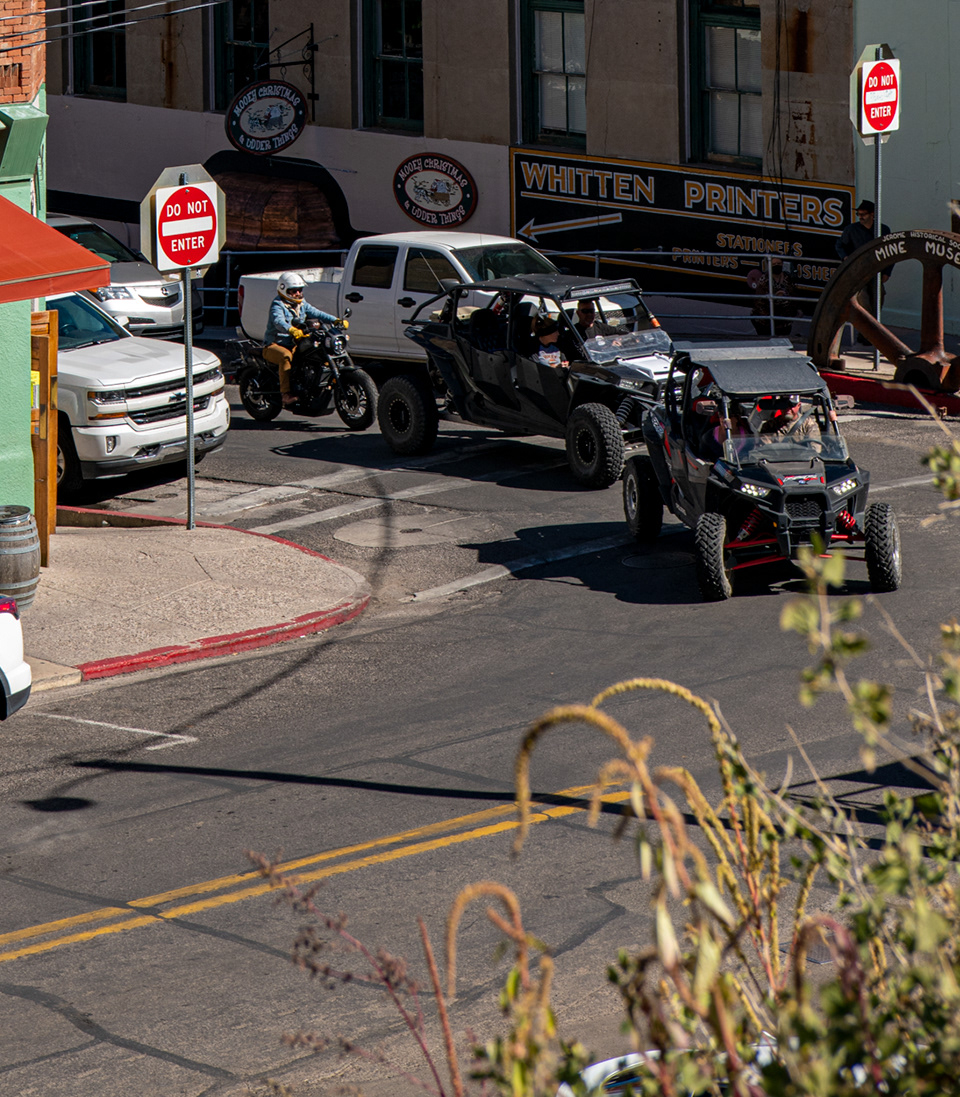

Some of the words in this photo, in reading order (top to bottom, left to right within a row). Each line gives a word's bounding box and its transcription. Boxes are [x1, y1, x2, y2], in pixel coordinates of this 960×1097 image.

[868, 76, 878, 88] DO
[881, 74, 894, 86] NOT
[233, 89, 257, 117] MOOEY
[258, 85, 301, 106] CHRISTMAS
[870, 105, 892, 119] ENTER
[246, 138, 272, 151] UDDER
[272, 123, 299, 149] THINGS
[398, 158, 423, 181] MOOEY
[424, 158, 468, 188] CHRISTMAS
[520, 161, 655, 204] WHITTEN
[684, 179, 844, 227] PRINTERS
[166, 203, 181, 217] DO
[187, 200, 208, 214] NOT
[411, 205, 438, 224] UDDER
[439, 204, 466, 224] THINGS
[171, 235, 205, 252] ENTER
[882, 231, 906, 242] JEROME
[910, 231, 946, 244] HISTORICAL
[874, 241, 907, 261] MINE
